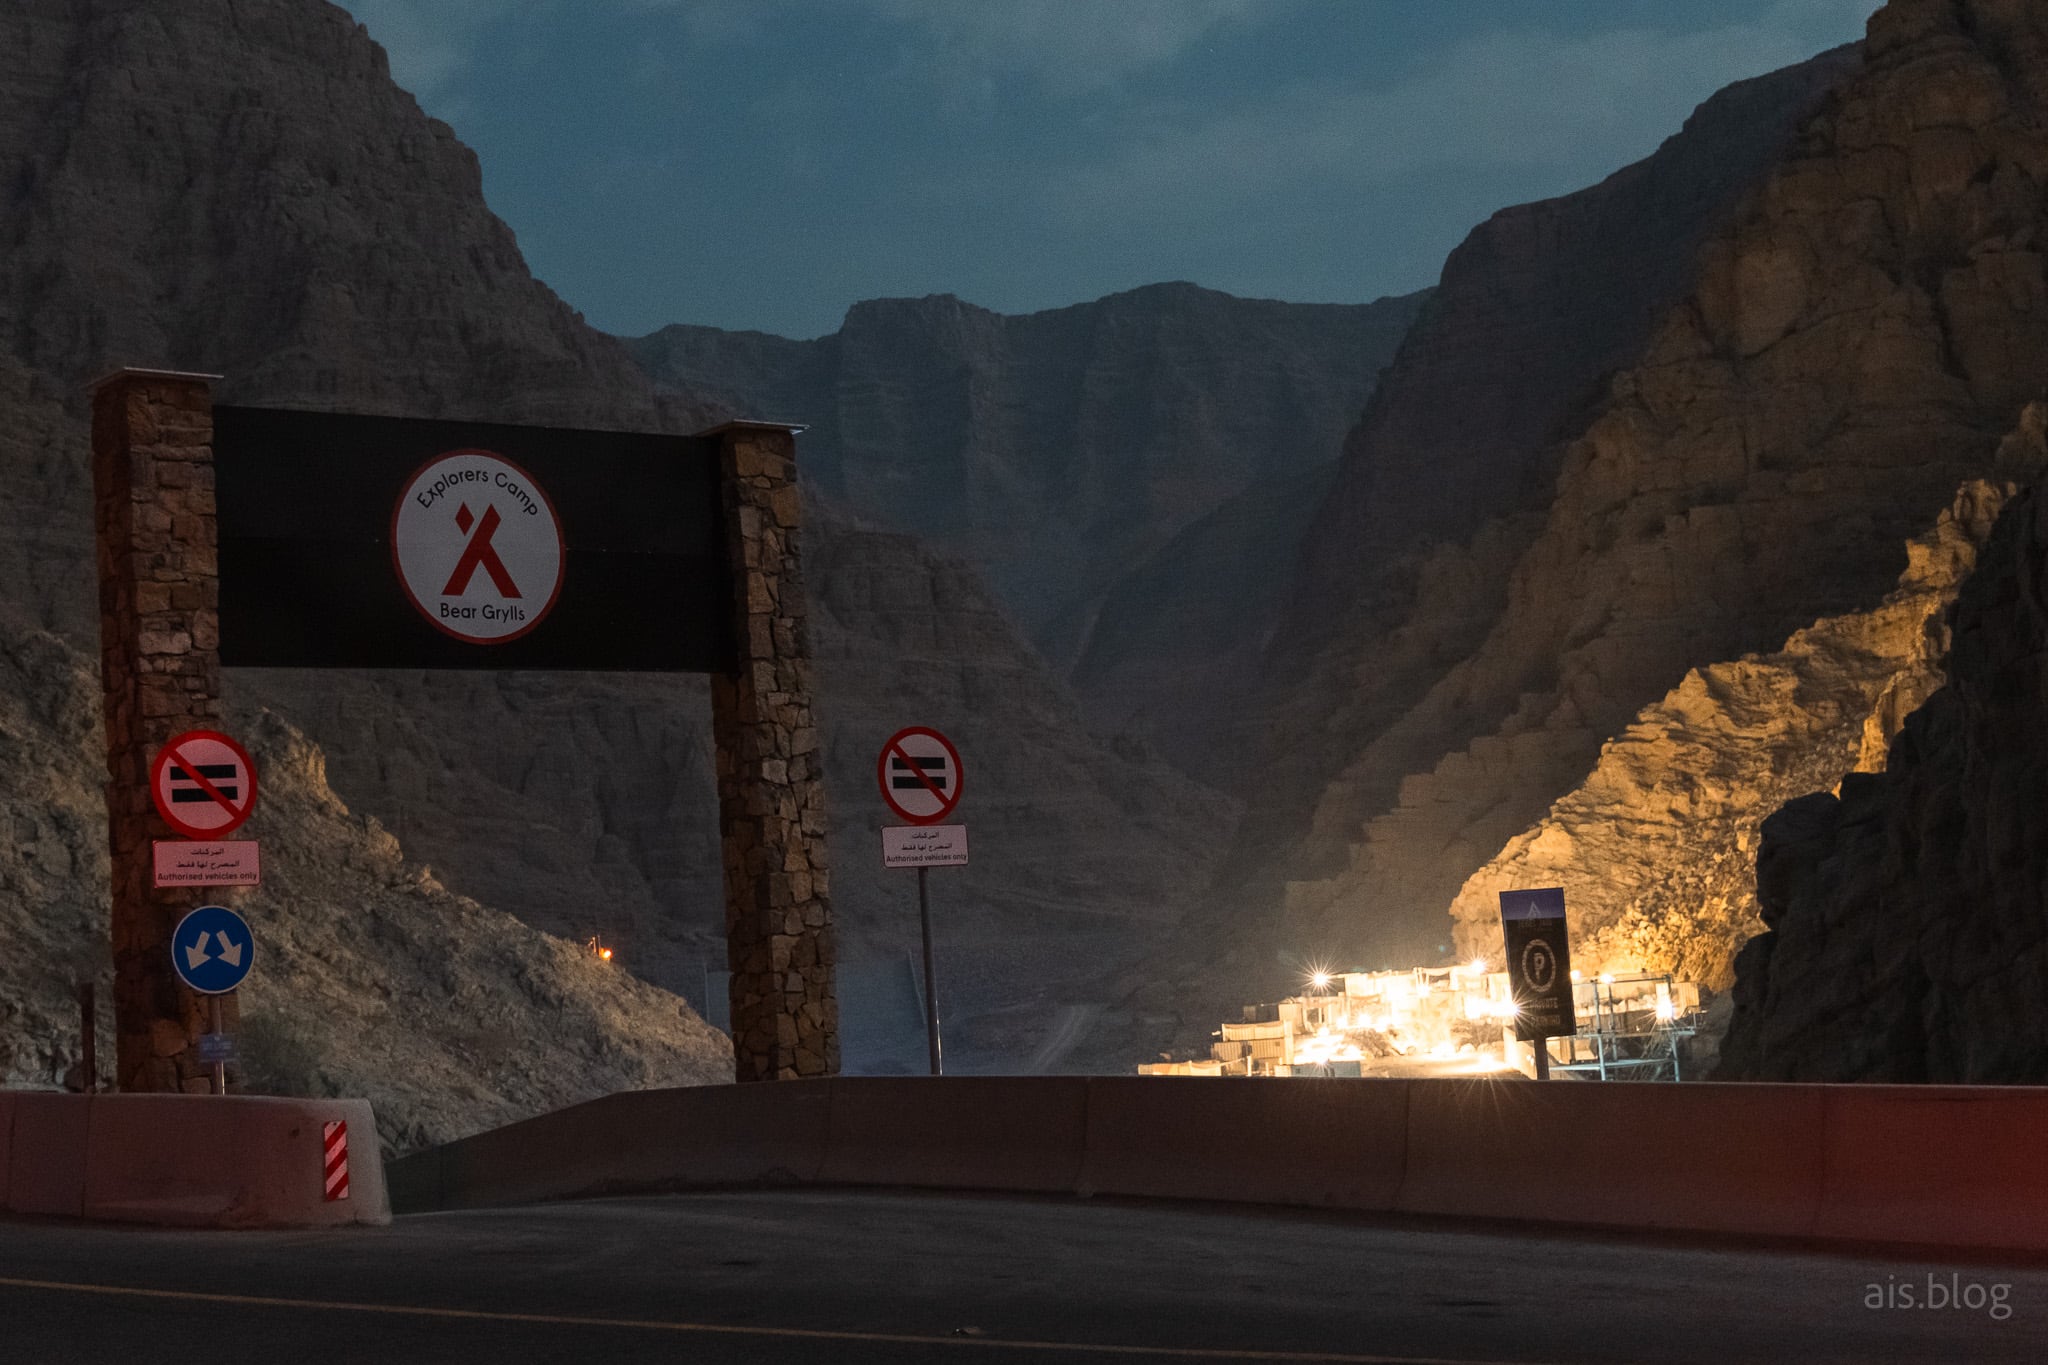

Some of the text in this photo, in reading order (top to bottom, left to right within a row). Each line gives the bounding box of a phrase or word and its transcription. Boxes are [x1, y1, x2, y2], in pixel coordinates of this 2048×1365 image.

[416, 470, 538, 516] Explorers Camp
[440, 603, 525, 623] Bear Grylls
[886, 852, 967, 863] Authorised vehicles only
[157, 871, 257, 881] Authorised vehicles only
[1534, 952, 1546, 980] P
